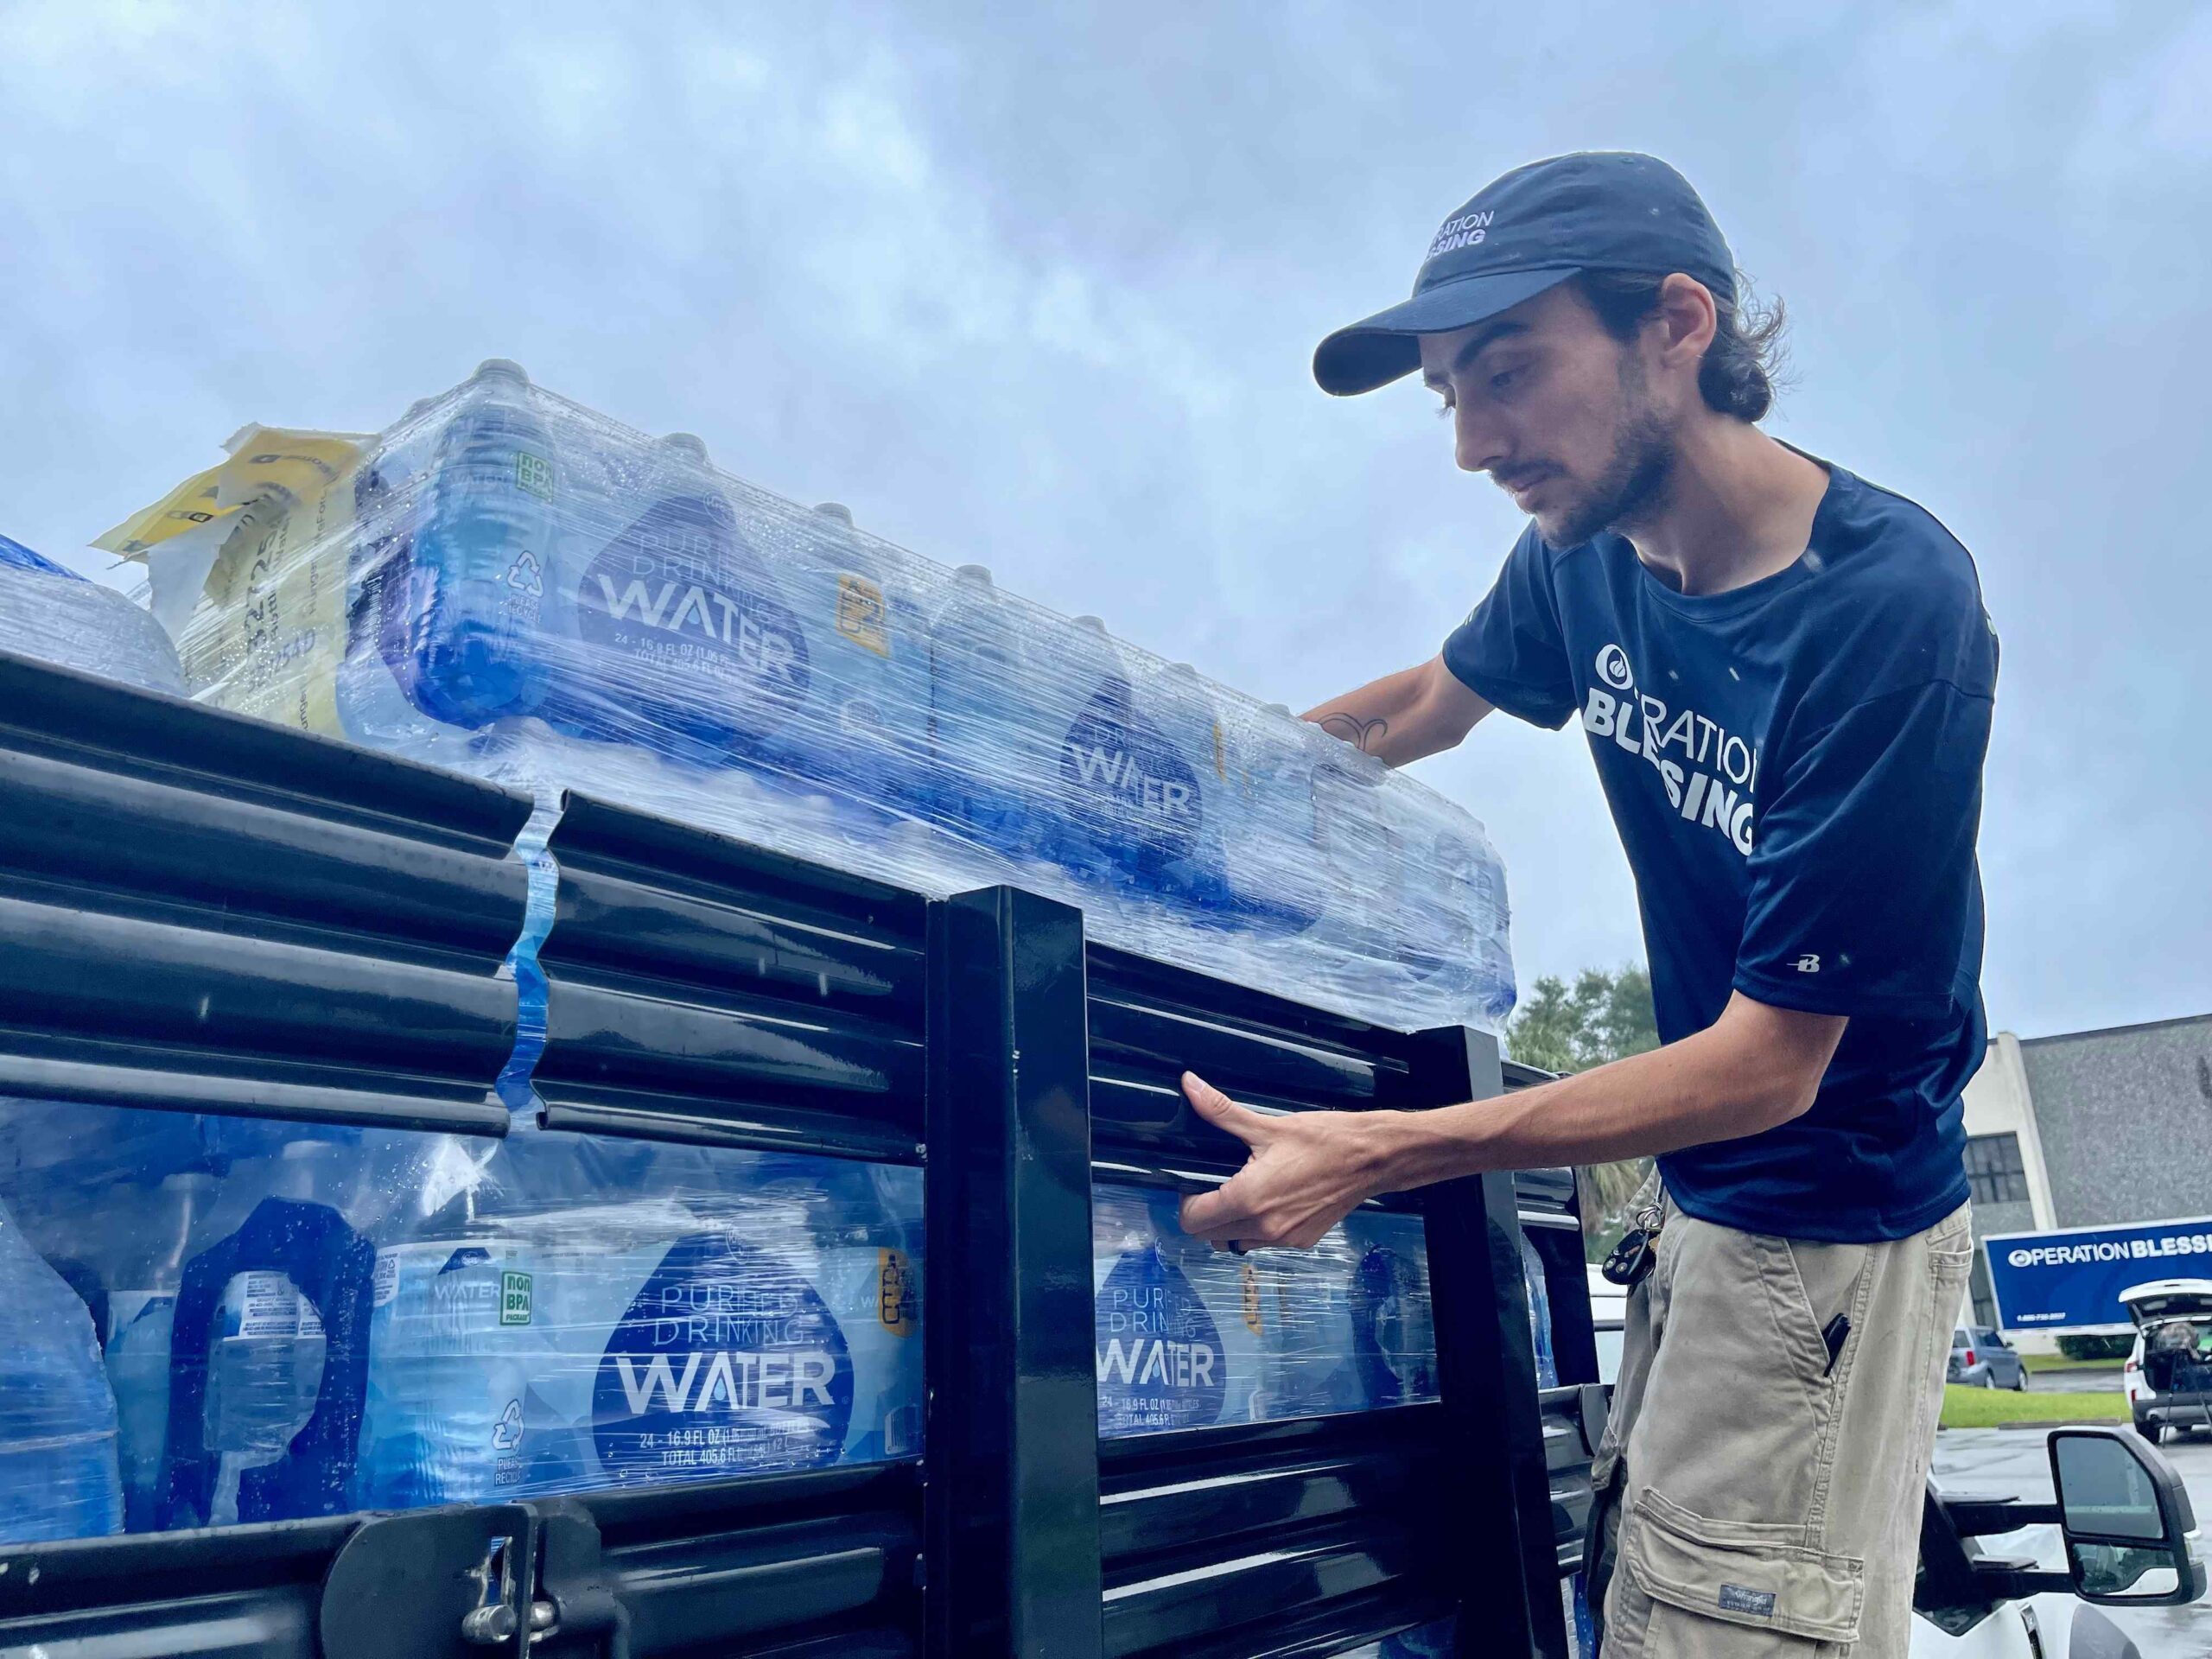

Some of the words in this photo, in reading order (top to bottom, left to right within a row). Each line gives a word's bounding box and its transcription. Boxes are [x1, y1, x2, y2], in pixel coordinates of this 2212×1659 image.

[597, 573, 798, 684] WATER
[614, 633, 628, 645] 24
[2008, 1240, 2131, 1268] OPERATION
[507, 1275, 531, 1293] non
[506, 1294, 530, 1312] BPA
[654, 1317, 804, 1347] DRINKING
[1096, 1338, 1215, 1388] WATER
[614, 1350, 837, 1415] WATER
[639, 1433, 654, 1449] 24
[667, 1430, 692, 1447] 16.9
[694, 1429, 706, 1446] FL
[708, 1427, 721, 1446] OZ
[661, 1451, 697, 1466] TOTAL
[700, 1448, 727, 1464] 405.6
